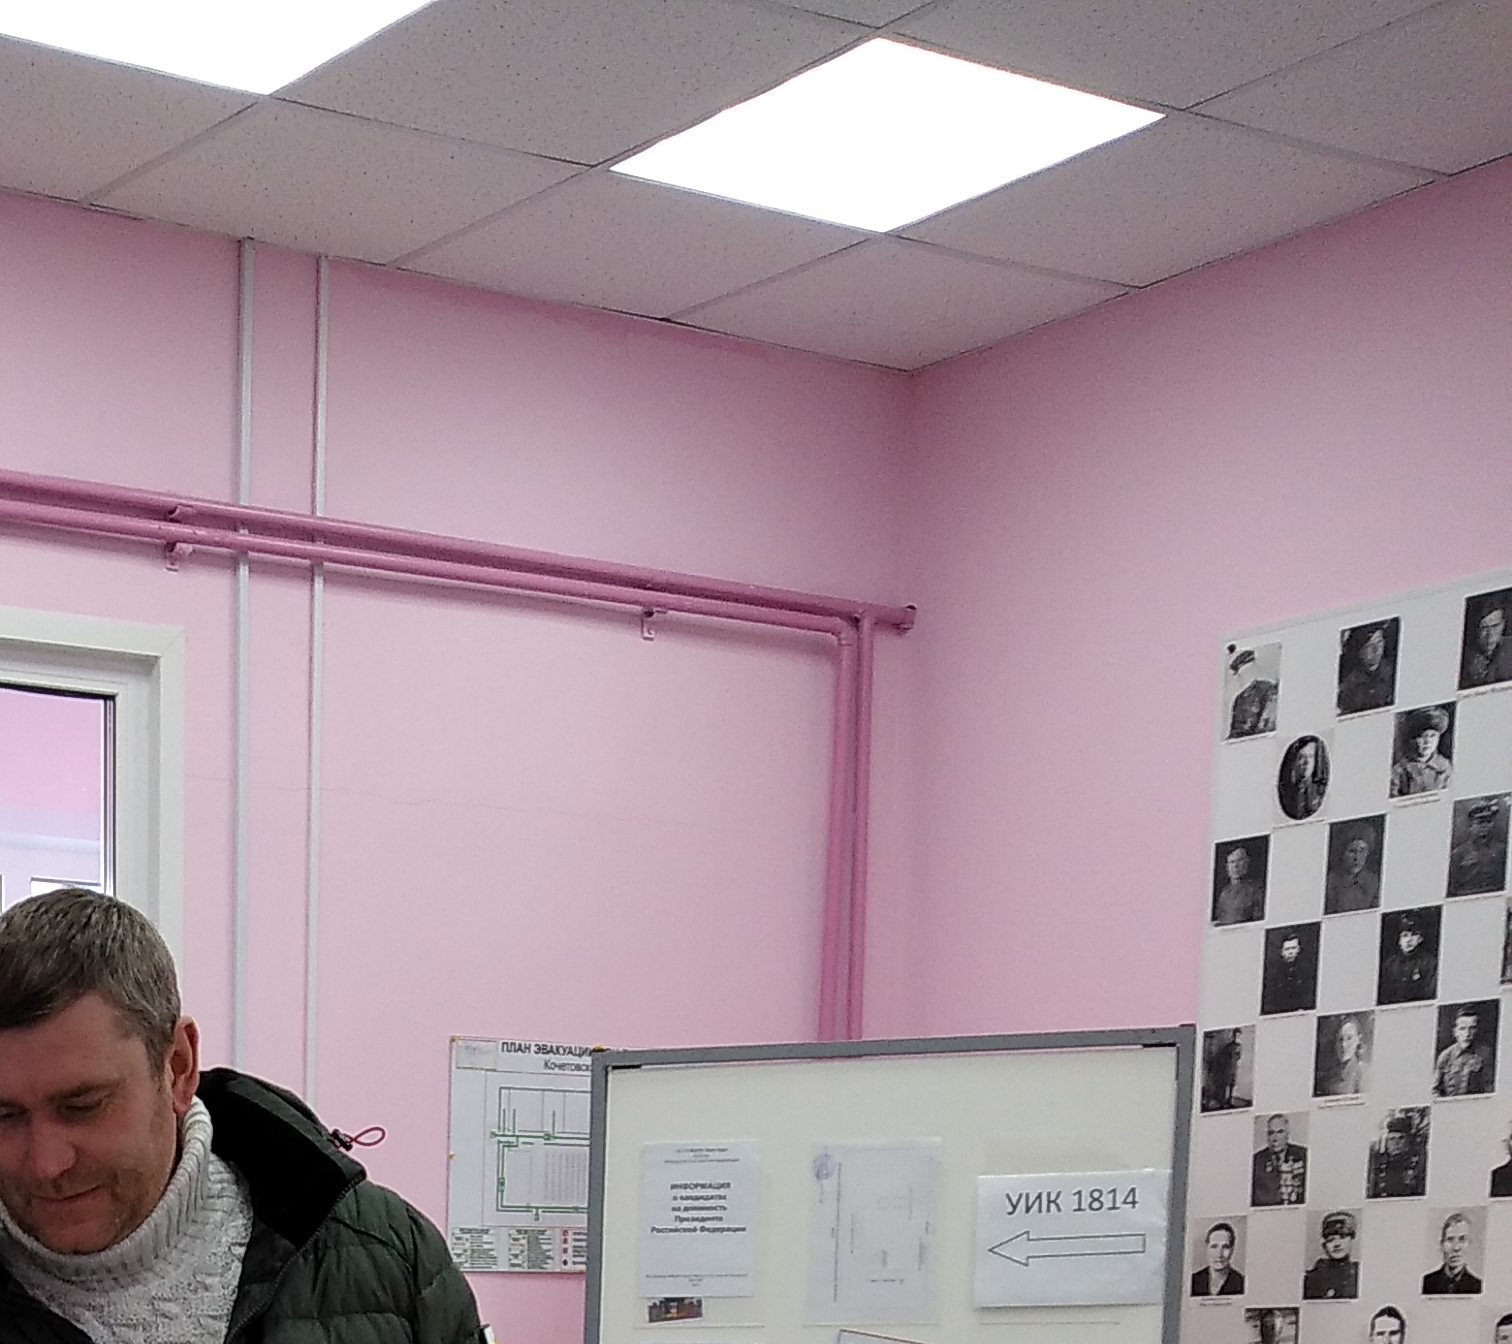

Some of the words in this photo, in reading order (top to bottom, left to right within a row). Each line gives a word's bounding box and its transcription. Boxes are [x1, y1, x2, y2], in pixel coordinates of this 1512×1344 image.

[501, 1042, 531, 1053] ПЛАН
[1006, 1190, 1062, 1216] УИК
[1072, 1186, 1139, 1213] 1814
